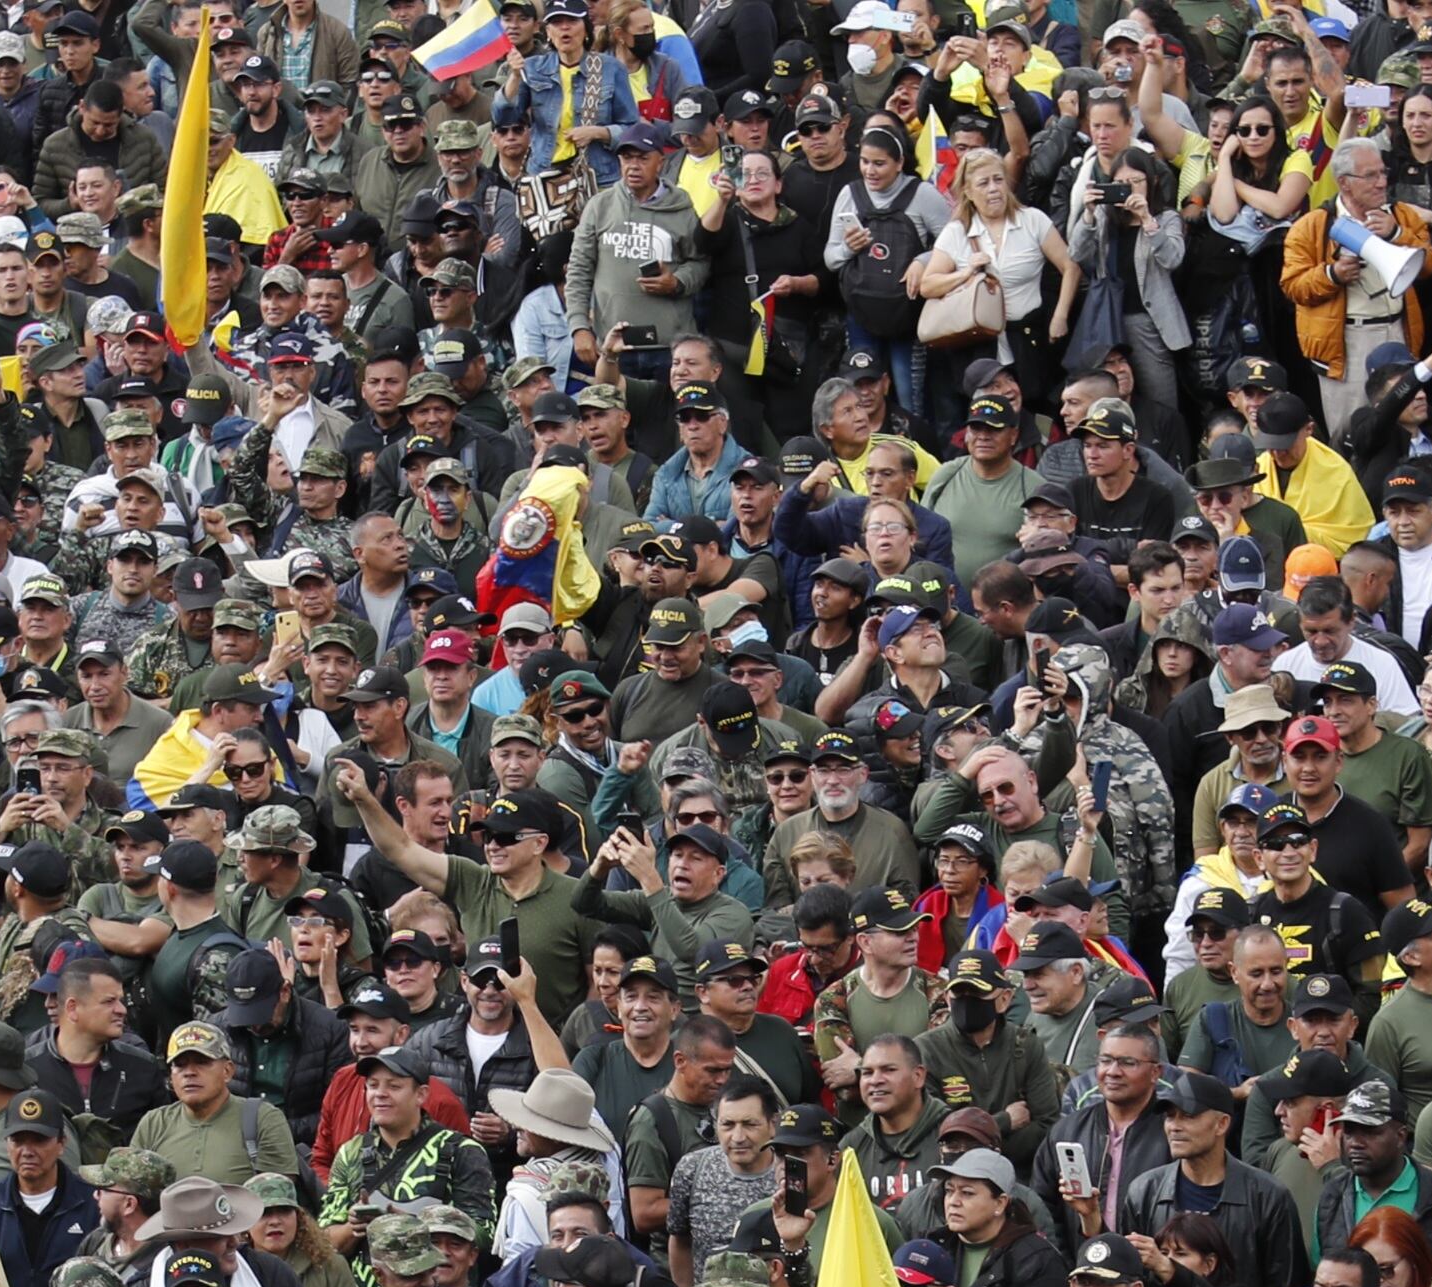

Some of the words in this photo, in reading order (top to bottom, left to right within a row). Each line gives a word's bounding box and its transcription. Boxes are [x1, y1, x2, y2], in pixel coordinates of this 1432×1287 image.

[624, 221, 650, 234] THE
[602, 233, 650, 247] NORTH
[614, 245, 650, 260] FACE
[186, 388, 220, 400] POLICIA
[650, 609, 686, 622] POLICIA
[816, 733, 853, 748] VETERANO
[1263, 804, 1304, 818] VETERANO
[871, 1170, 924, 1195] ORDA
[169, 1255, 212, 1273] VETERANO
